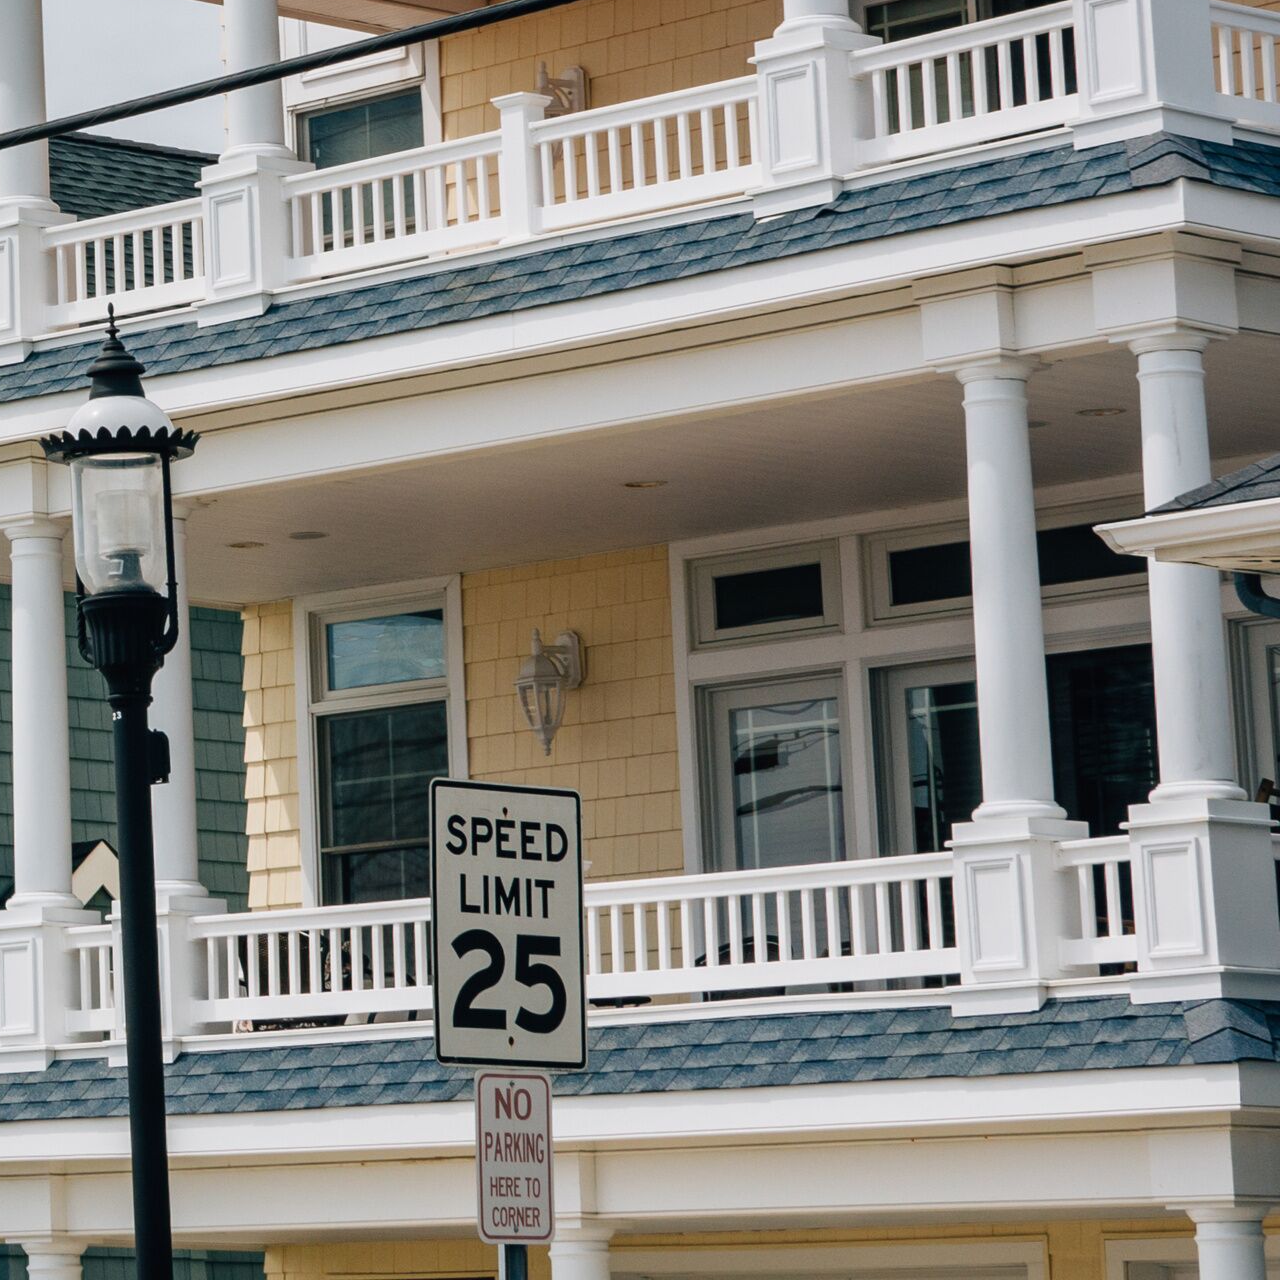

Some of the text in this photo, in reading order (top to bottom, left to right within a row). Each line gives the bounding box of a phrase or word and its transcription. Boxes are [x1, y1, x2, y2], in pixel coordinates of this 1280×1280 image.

[445, 814, 568, 862] SPEED
[460, 873, 555, 919] LIMIT
[451, 928, 567, 1034] 25
[494, 1087, 532, 1120] NO
[484, 1131, 544, 1164] PARKING
[490, 1176, 540, 1198] HERE TO
[492, 1206, 541, 1228] CORNER
